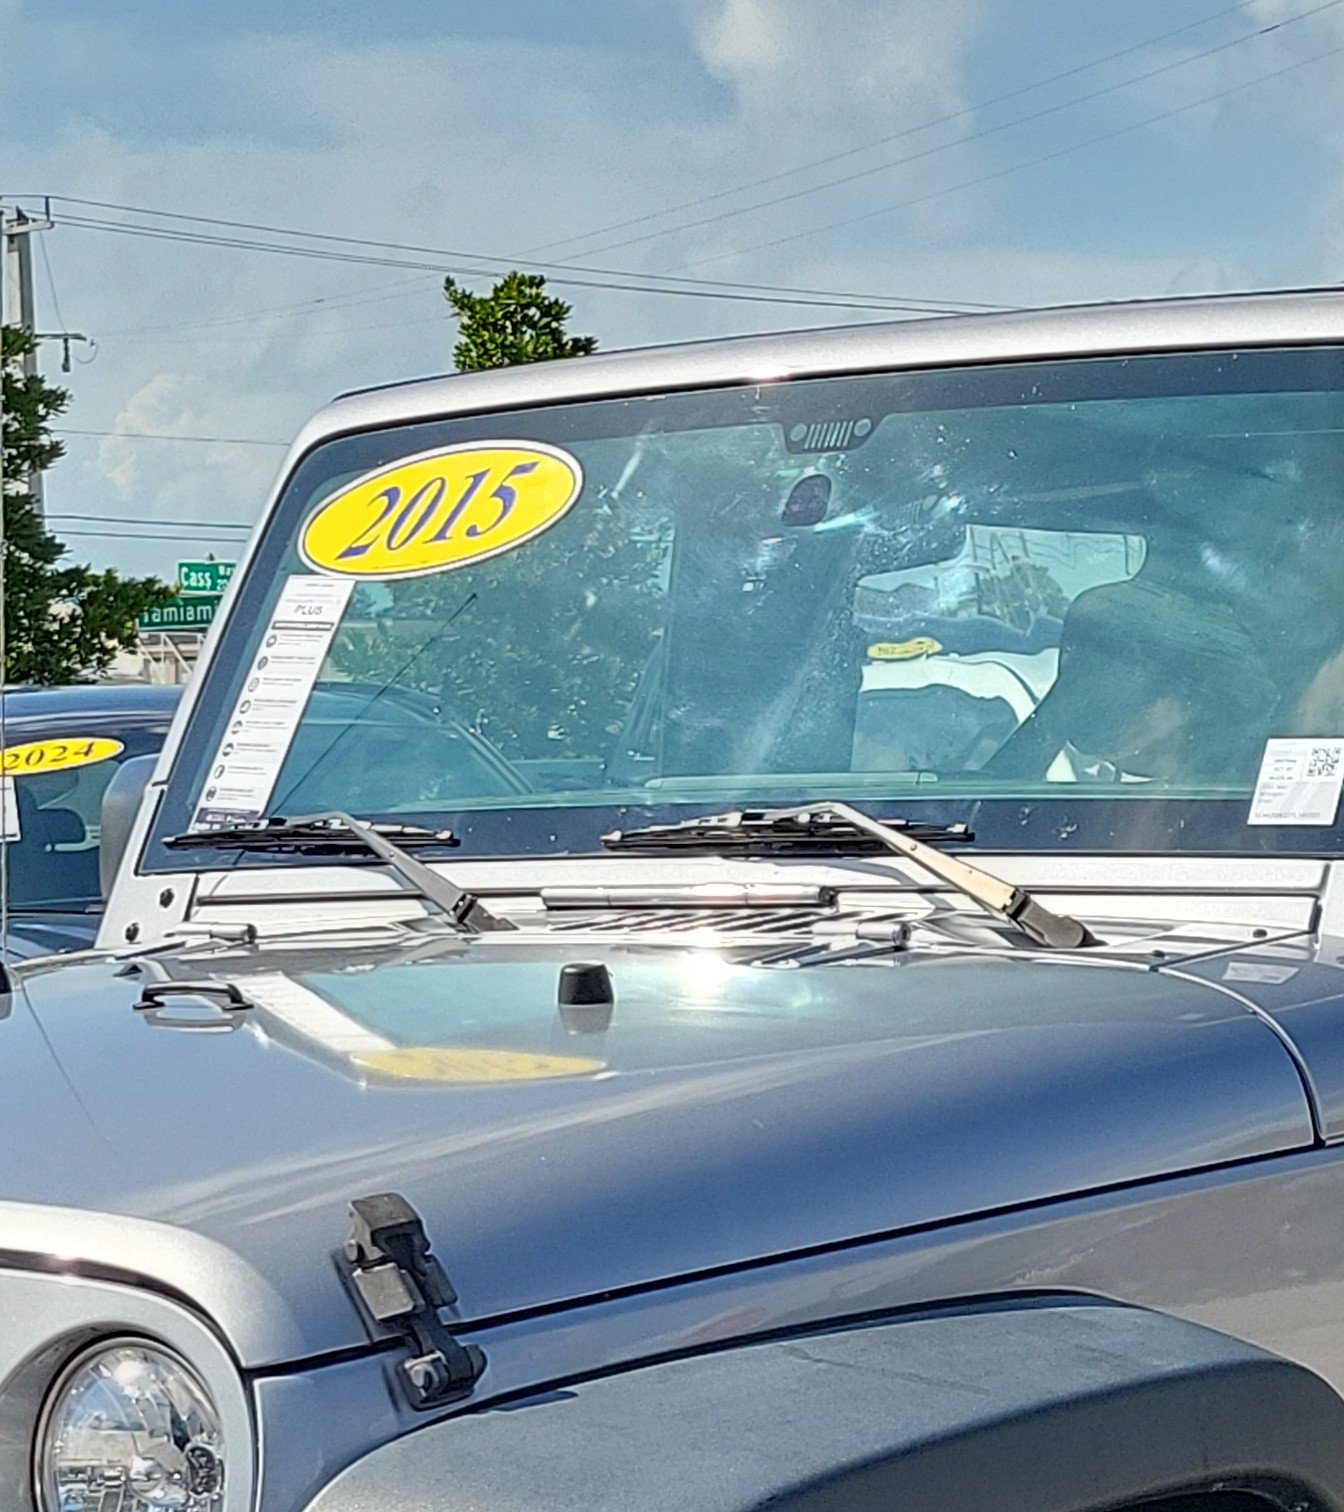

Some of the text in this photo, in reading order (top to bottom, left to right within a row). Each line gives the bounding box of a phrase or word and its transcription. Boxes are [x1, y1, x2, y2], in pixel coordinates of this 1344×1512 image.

[335, 461, 540, 561] 2015
[181, 566, 211, 589] Cass
[3, 741, 96, 771] 2024
